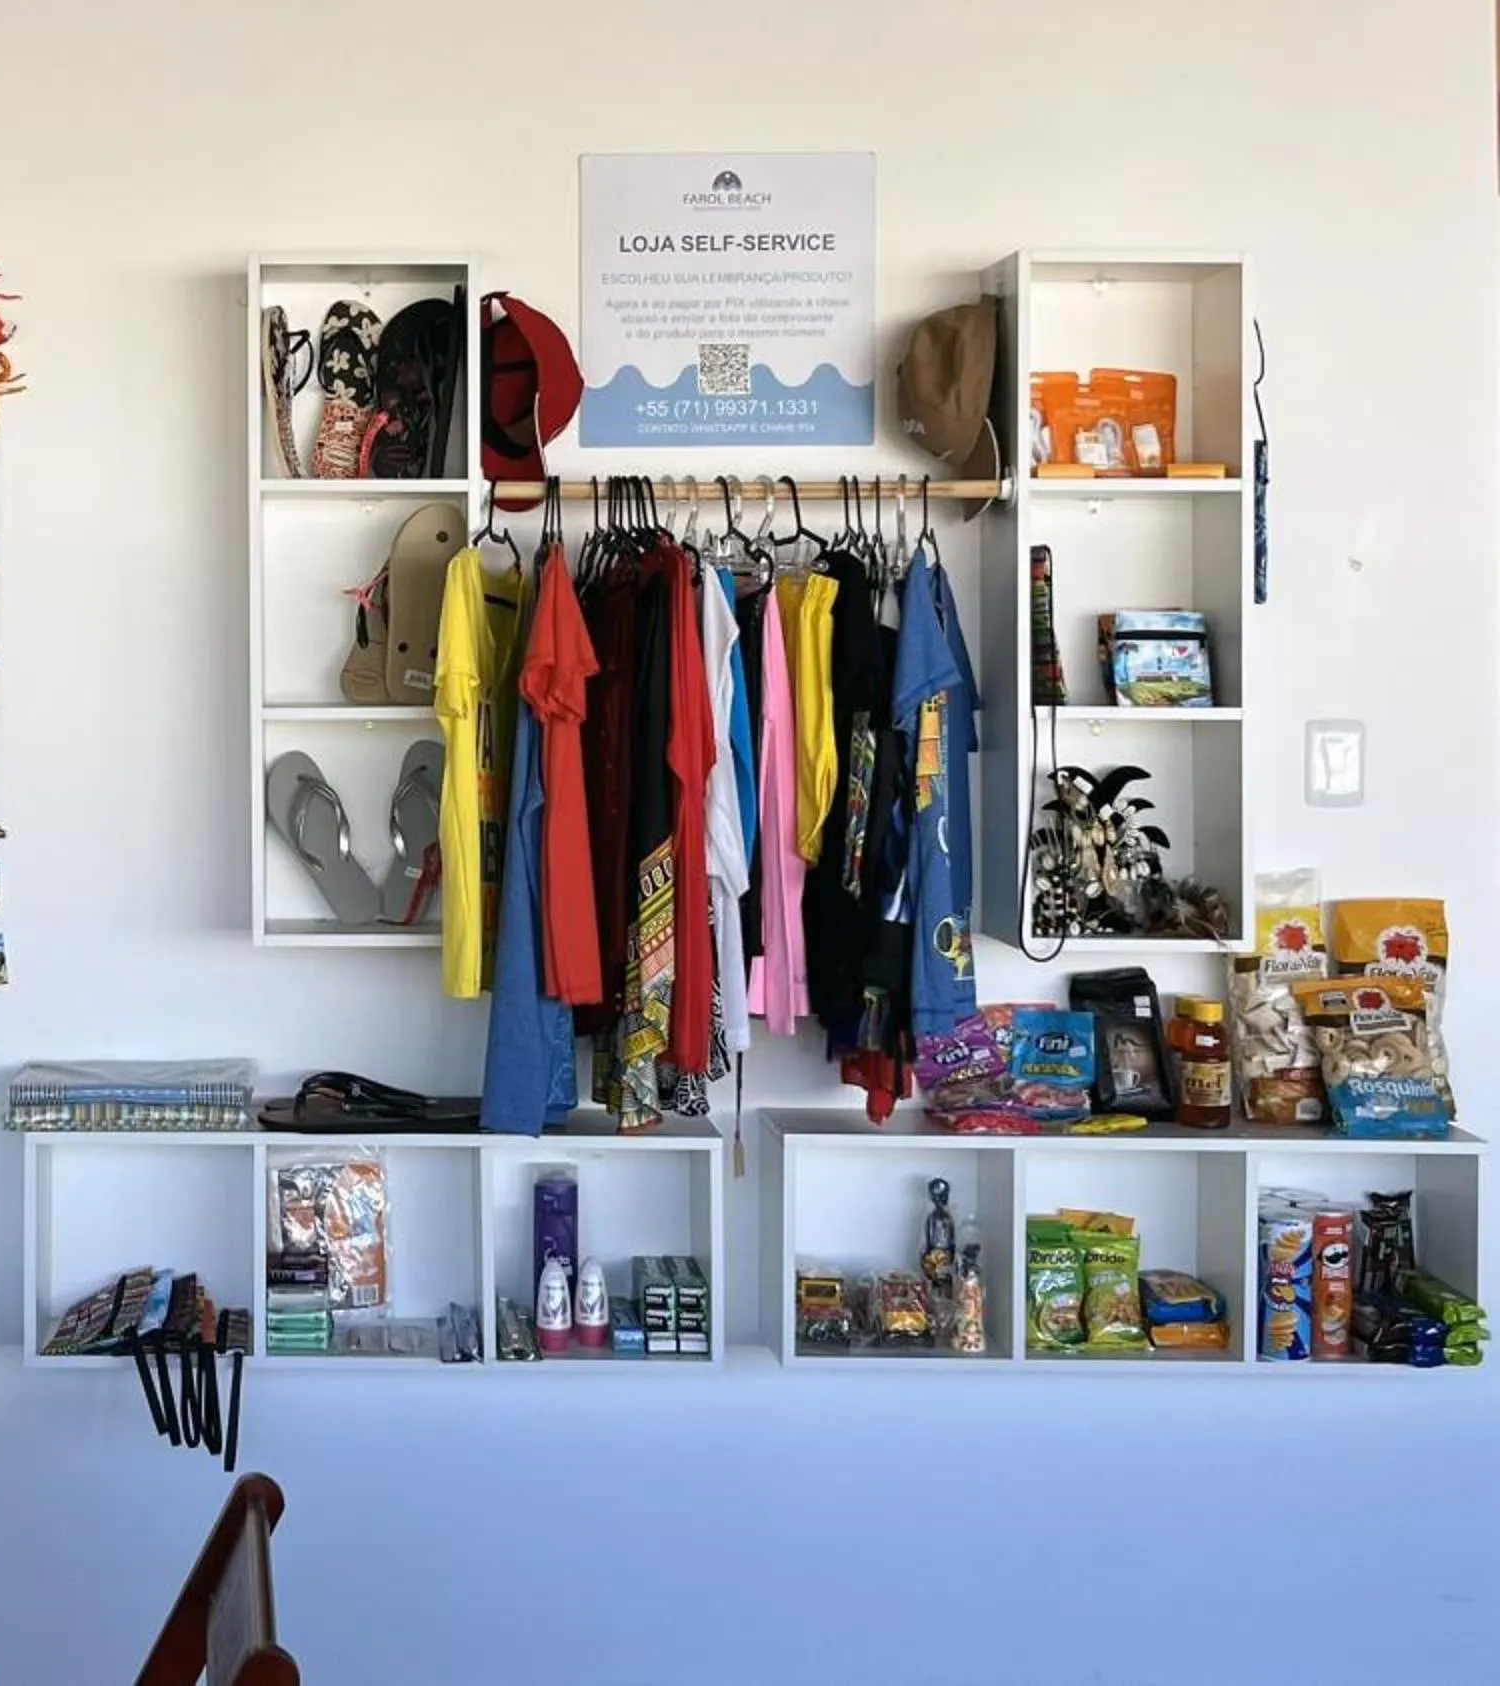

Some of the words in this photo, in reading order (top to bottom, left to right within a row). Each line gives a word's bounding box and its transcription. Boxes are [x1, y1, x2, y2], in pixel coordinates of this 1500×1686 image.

[619, 235, 676, 253] LOJA
[680, 233, 836, 252] SELF-SERVICE
[636, 401, 669, 418] +55
[673, 400, 709, 420] (71)
